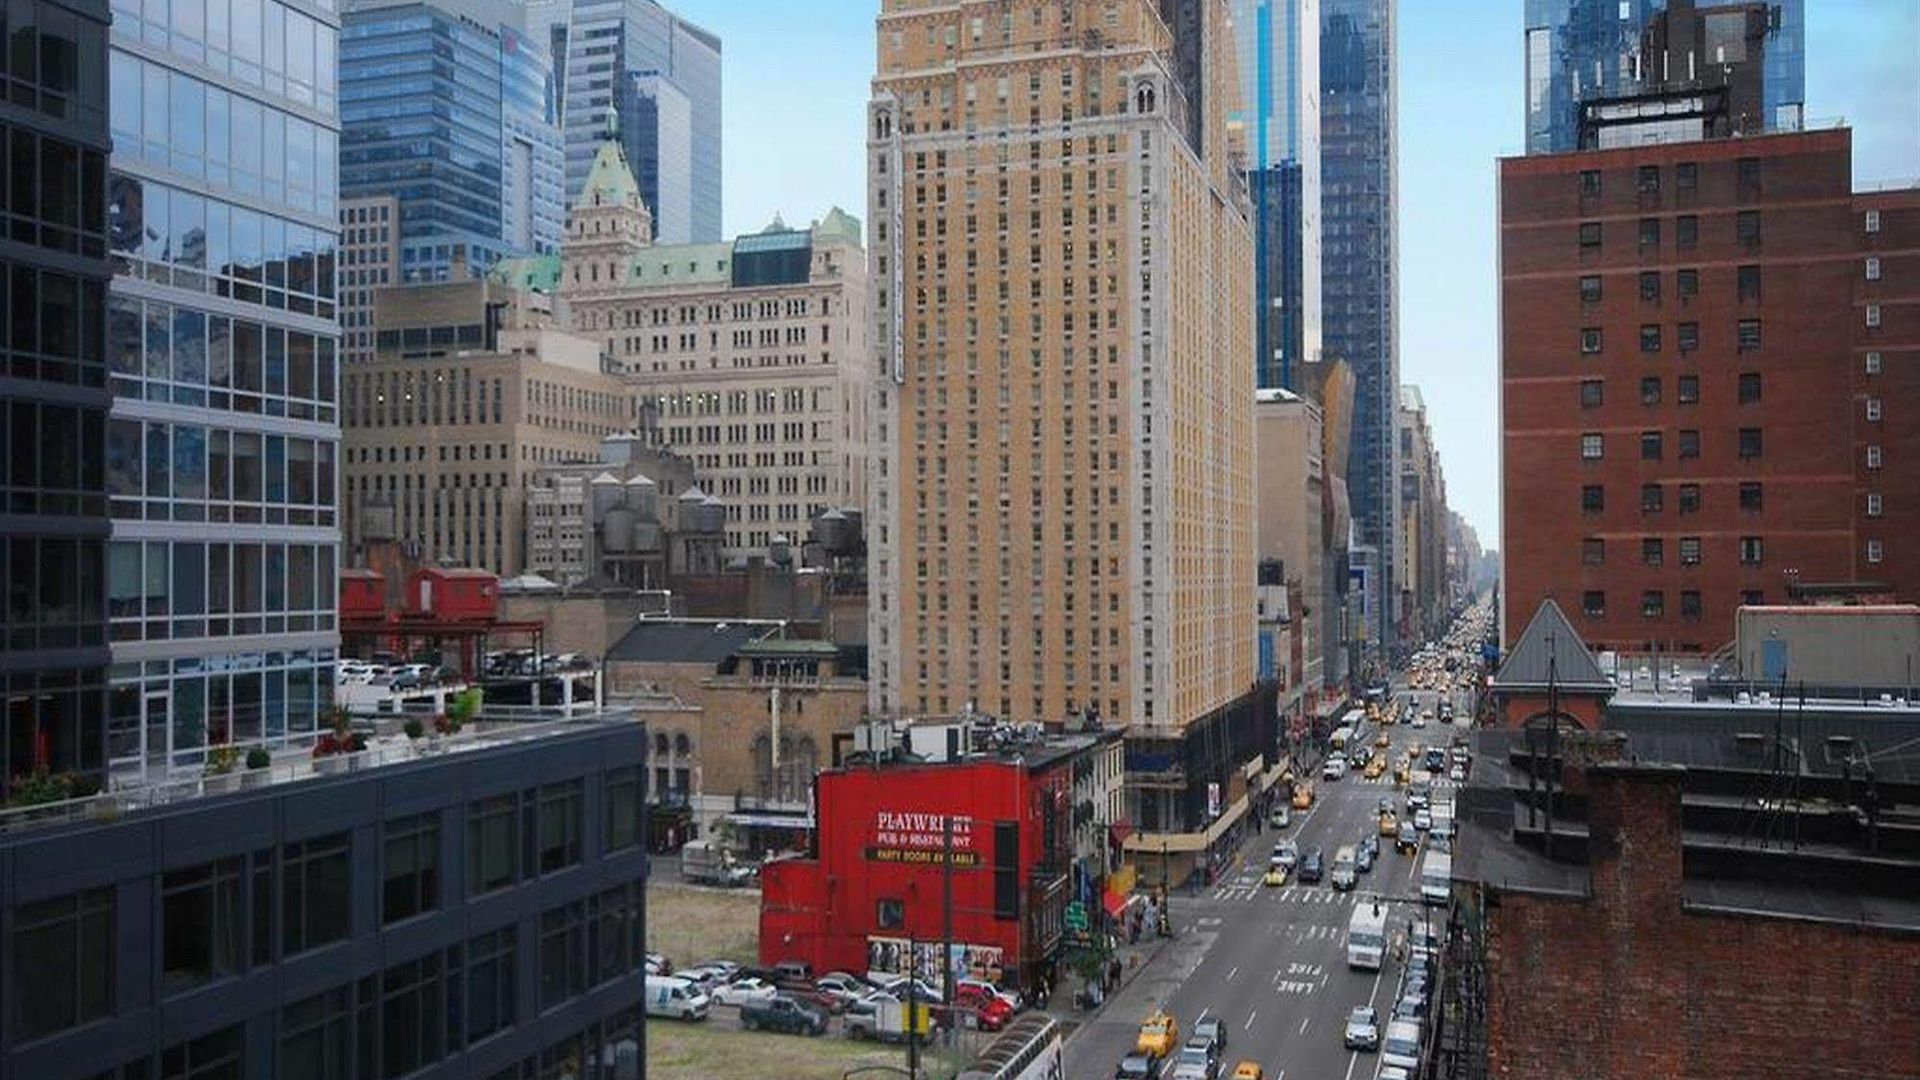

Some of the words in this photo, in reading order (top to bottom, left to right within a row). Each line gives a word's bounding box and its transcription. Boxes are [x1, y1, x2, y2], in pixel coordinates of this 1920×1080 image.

[878, 812, 972, 833] PLAYWRIHT
[910, 834, 971, 847] RESTAUANT
[1277, 981, 1314, 994] LANE
